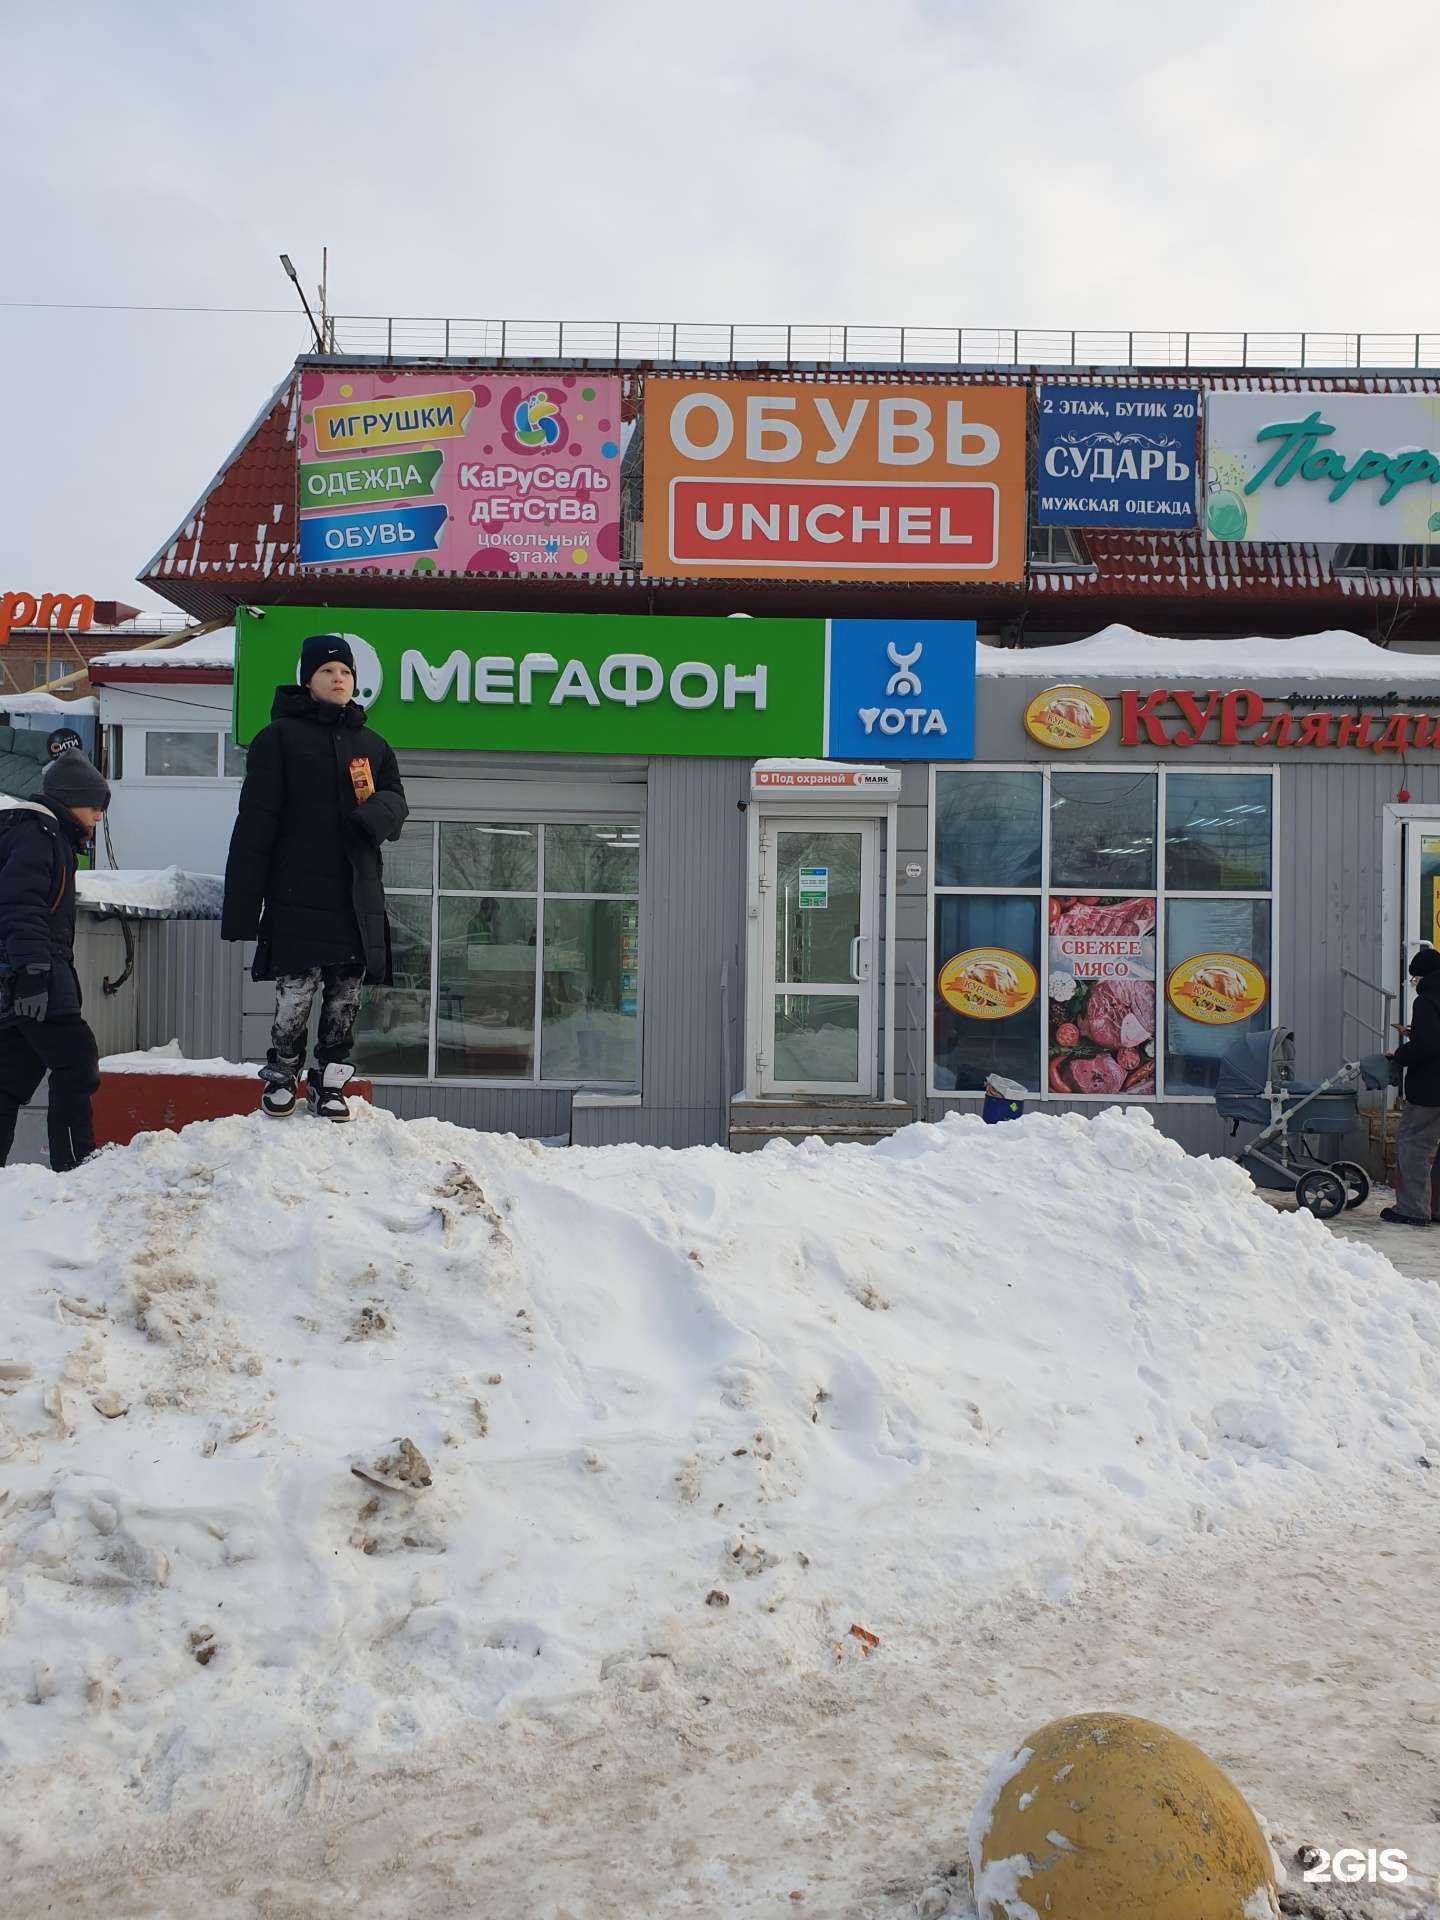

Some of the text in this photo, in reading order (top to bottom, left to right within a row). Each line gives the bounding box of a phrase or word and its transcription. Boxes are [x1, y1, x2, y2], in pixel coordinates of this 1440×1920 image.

[329, 406, 453, 438] ИГРУШКИ
[1043, 400, 1052, 413] 2
[1059, 400, 1109, 418] ЭТАЖ,
[1115, 403, 1167, 417] БУТИК
[669, 392, 1001, 467] ОБУВЬ
[1045, 446, 1190, 483] СУДАРЬ
[1244, 411, 1440, 507] Парф
[307, 465, 422, 497] ОДЕЖДА
[1041, 497, 1191, 514] МУЖСКАЯ ОДЕЖДА
[325, 523, 415, 549] ОБУВЬ
[696, 502, 973, 545] UNICHEL
[0, 591, 95, 646] рт
[858, 707, 947, 735] YOTA
[771, 774, 846, 784] Под охраной
[1061, 940, 1141, 956] СВЕЖЕЕ
[1074, 961, 1128, 977] МЯСО
